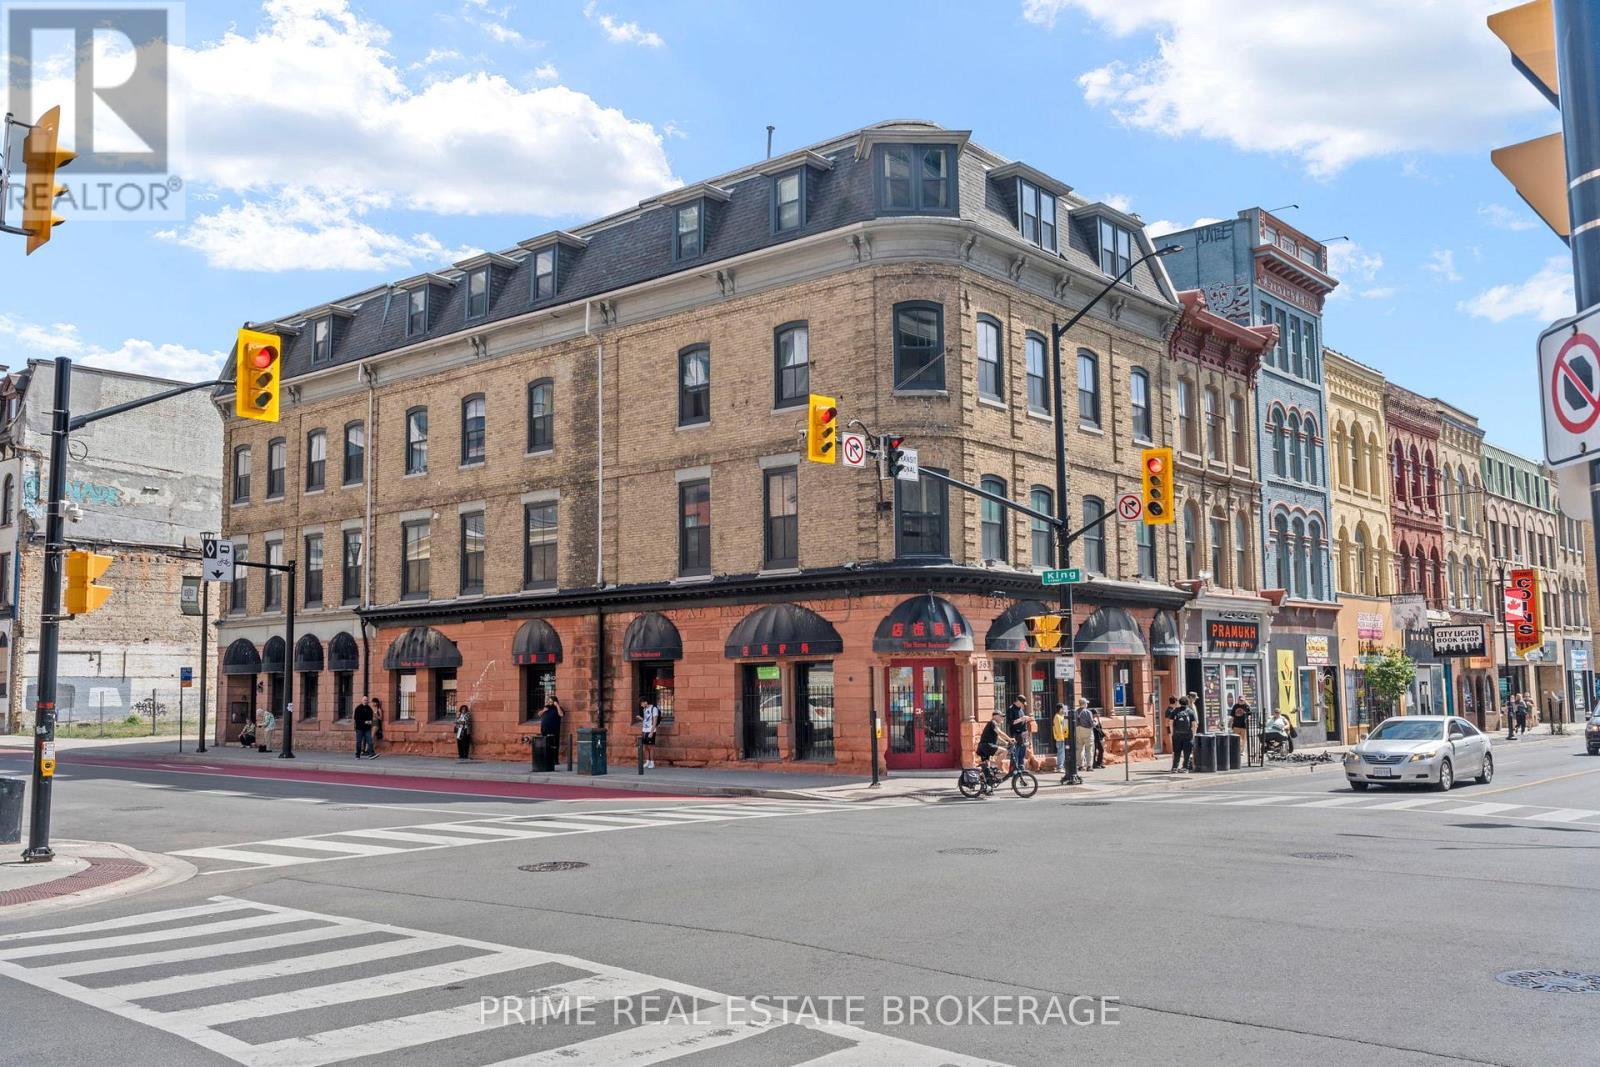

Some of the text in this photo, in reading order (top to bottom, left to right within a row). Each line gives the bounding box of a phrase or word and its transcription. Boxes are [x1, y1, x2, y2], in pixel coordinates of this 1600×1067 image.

[1047, 571, 1076, 580] King
[1212, 623, 1256, 639] PRAMUKH
[1436, 630, 1453, 638] CITY
